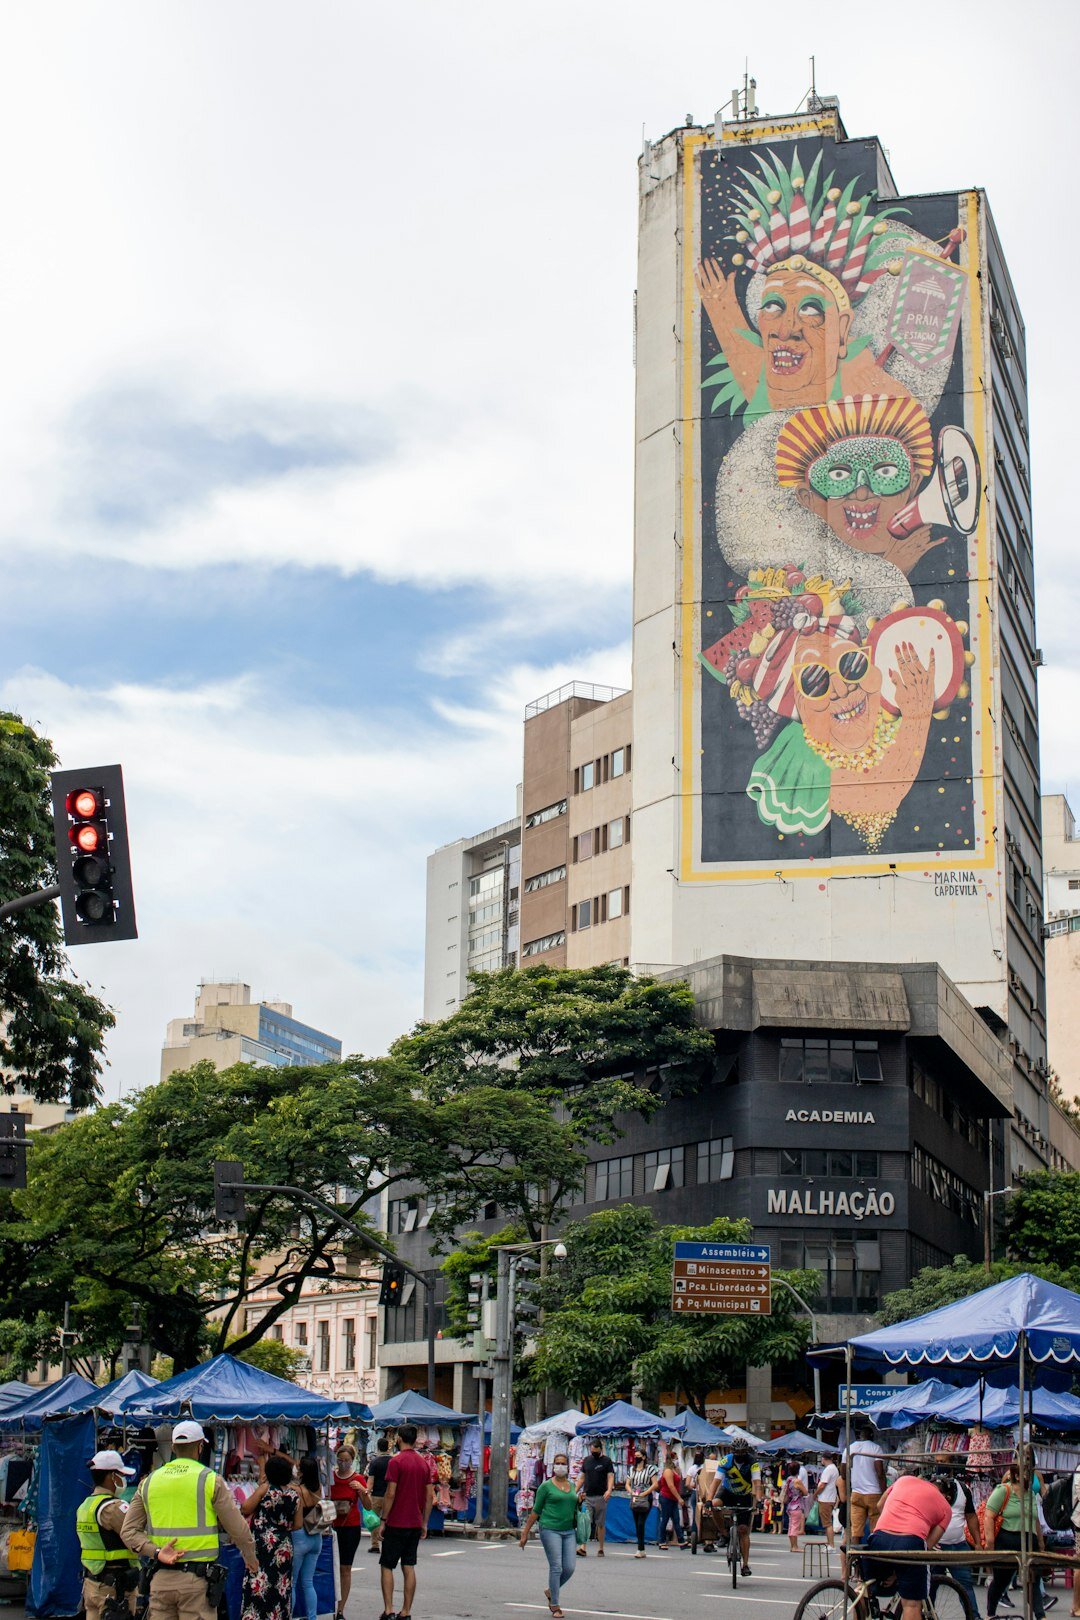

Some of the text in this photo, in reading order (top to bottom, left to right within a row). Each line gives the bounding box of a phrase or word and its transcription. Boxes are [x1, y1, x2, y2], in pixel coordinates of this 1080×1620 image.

[905, 313, 939, 328] PRAIA
[934, 871, 976, 884] MARINA
[934, 884, 978, 897] CAPDEVILA
[785, 1109, 875, 1124] ACADEMIA
[767, 1187, 895, 1220] MALHAÇÃO
[701, 1247, 755, 1258] Assembléia
[698, 1265, 756, 1276] Minascentro
[709, 1282, 756, 1292] Liberdade
[687, 1299, 749, 1310] Pq. Municipal
